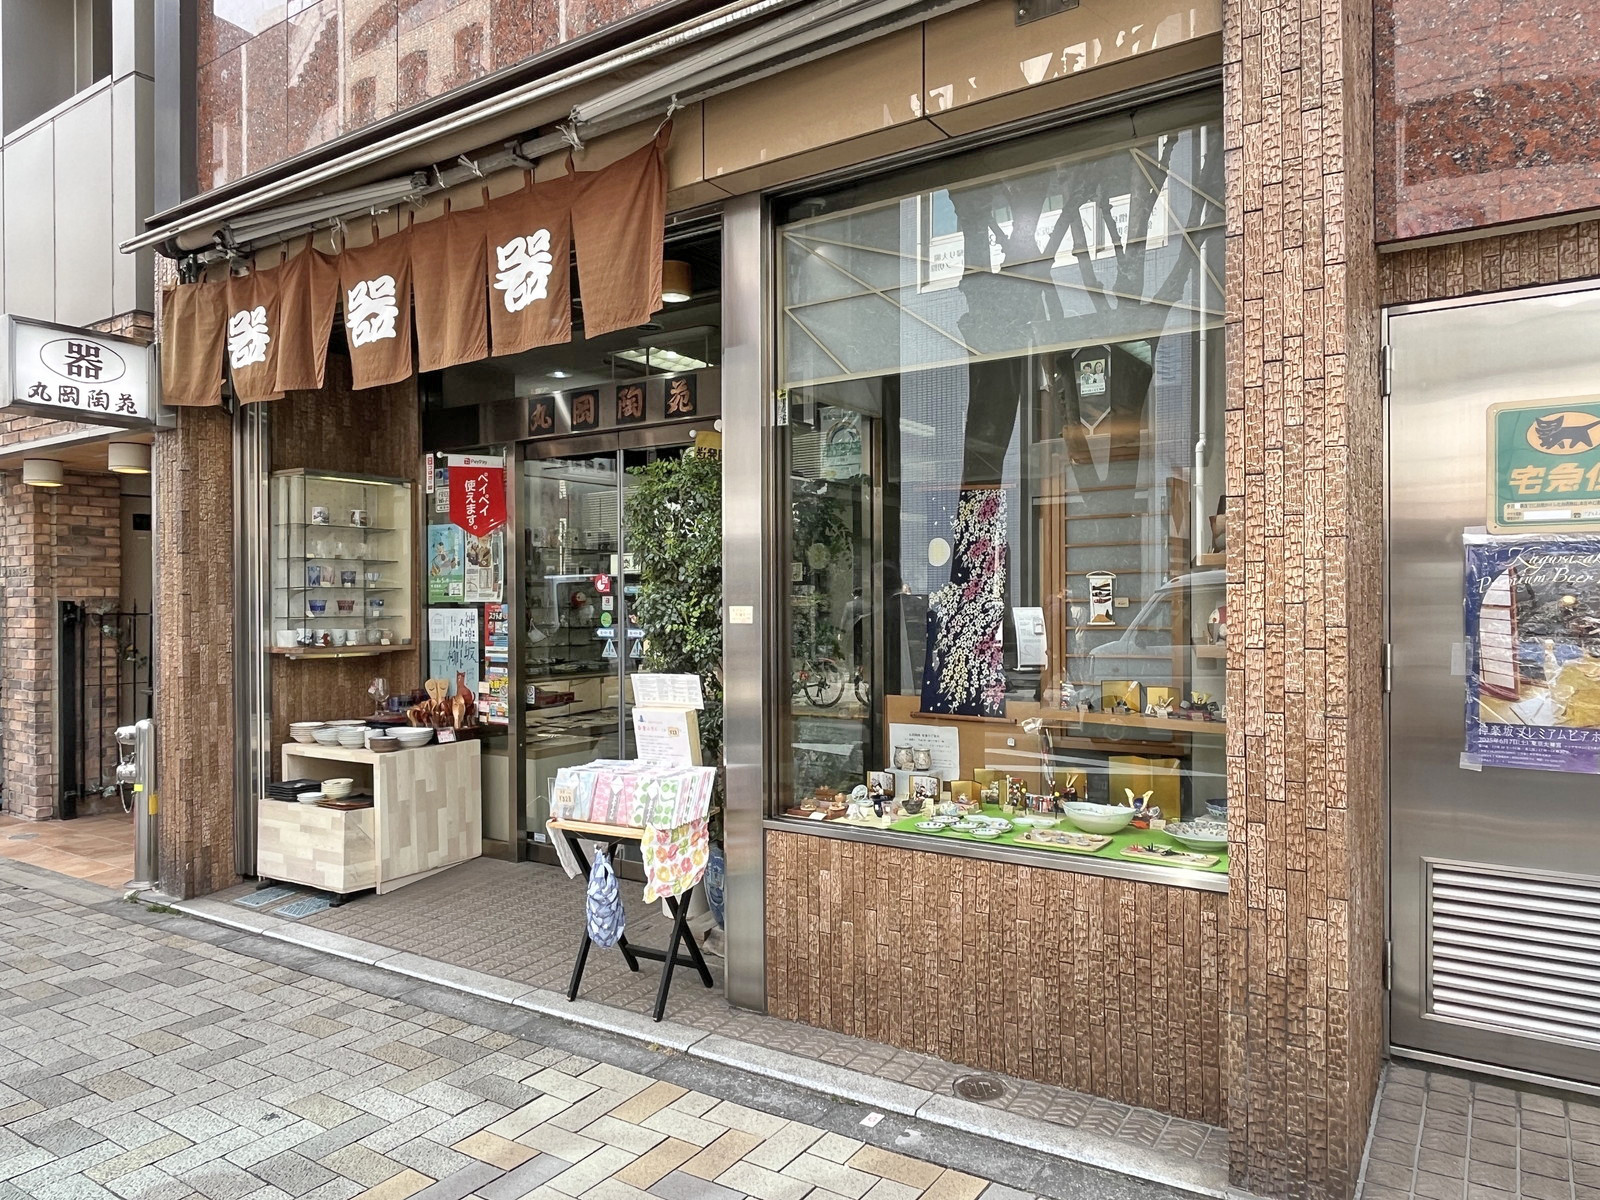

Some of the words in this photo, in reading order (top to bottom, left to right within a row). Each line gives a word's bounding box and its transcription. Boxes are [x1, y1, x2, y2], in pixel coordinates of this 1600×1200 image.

[493, 228, 553, 313] 器
[346, 274, 399, 348] 器
[64, 341, 103, 380] 器
[228, 305, 271, 369] 器
[28, 380, 138, 415] 丸岡陶苑
[531, 378, 693, 431] 丸岡陶苑
[465, 480, 478, 530] 使えます。
[478, 472, 490, 516] ペイペイ
[1552, 567, 1594, 583] Beer
[463, 611, 479, 664] 神楽坂
